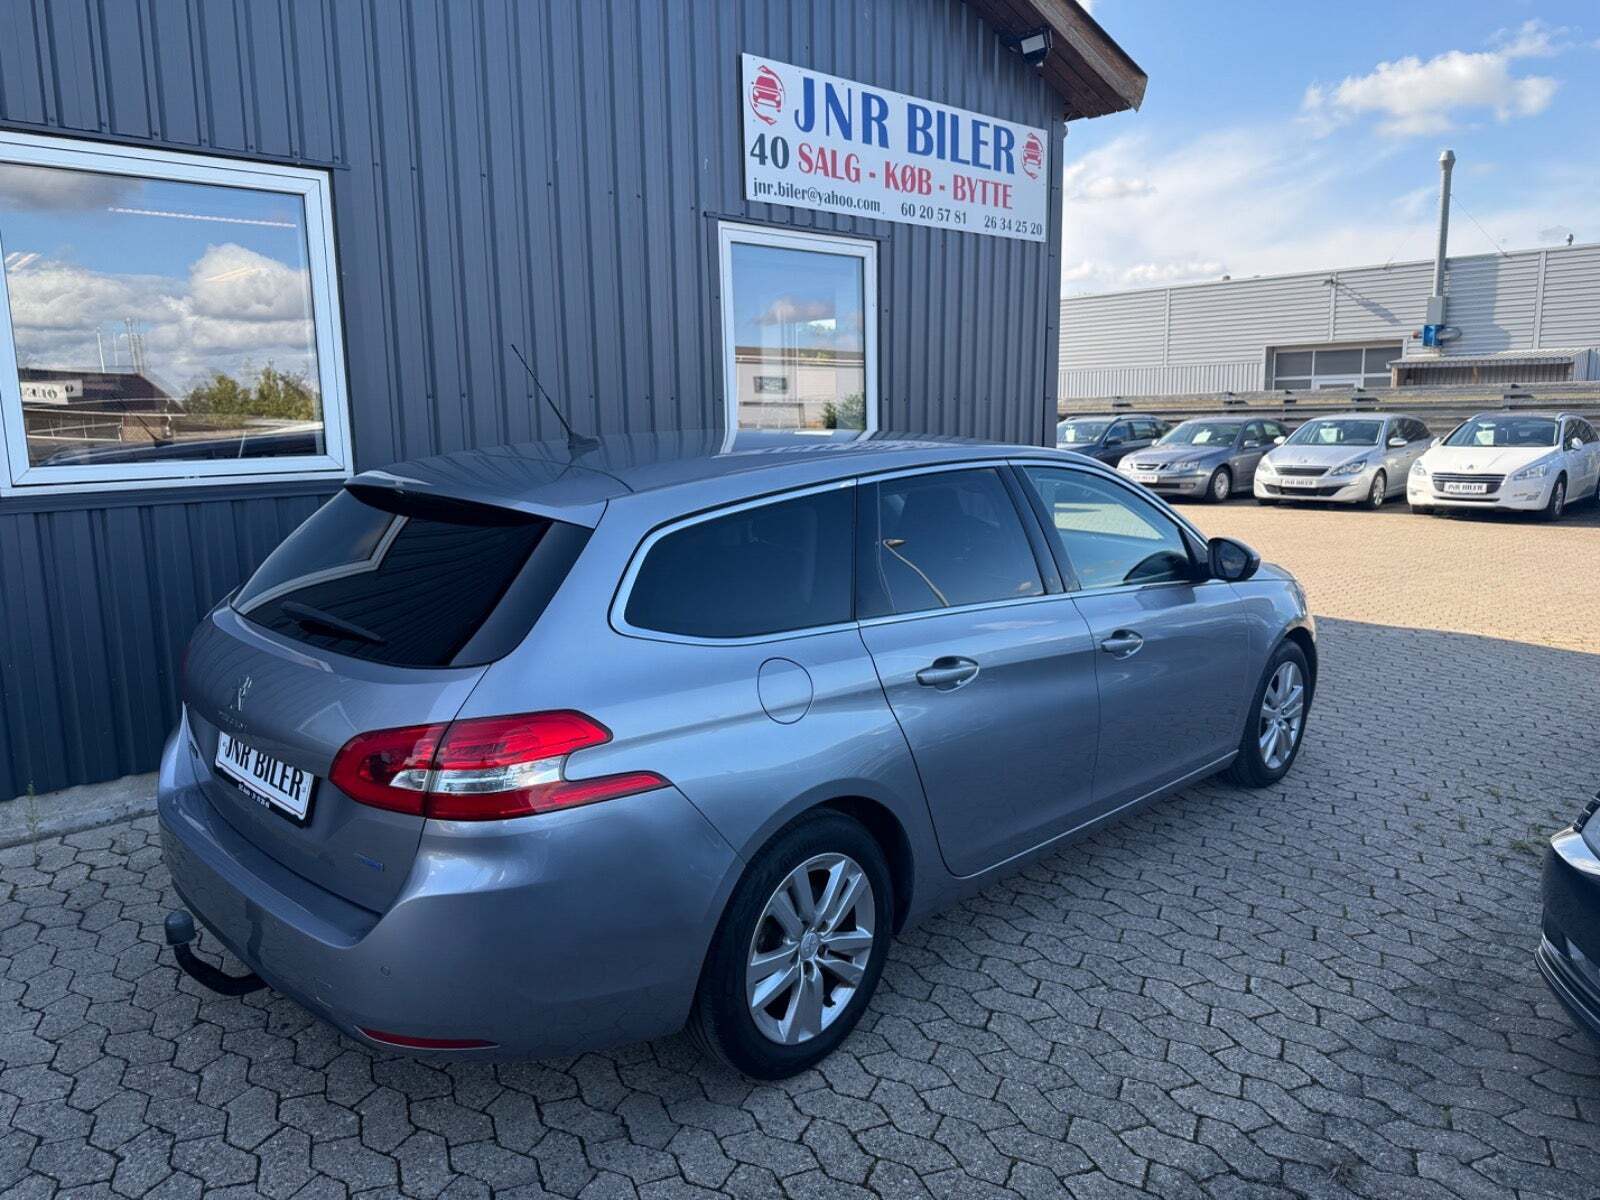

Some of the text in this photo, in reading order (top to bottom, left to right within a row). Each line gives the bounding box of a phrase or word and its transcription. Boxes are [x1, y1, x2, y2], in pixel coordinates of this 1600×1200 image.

[794, 77, 1015, 175] JNR BILER
[750, 133, 790, 169] 40
[753, 177, 881, 210] jnr.biler@yahoo.com
[797, 143, 861, 184] SALG
[884, 160, 932, 196] KØB
[952, 174, 1013, 210] BYTTE
[901, 202, 967, 225] 60 20 57 81
[984, 215, 1043, 236] 26 34 25 20
[225, 737, 251, 770] JNR
[253, 751, 304, 802] BILER
